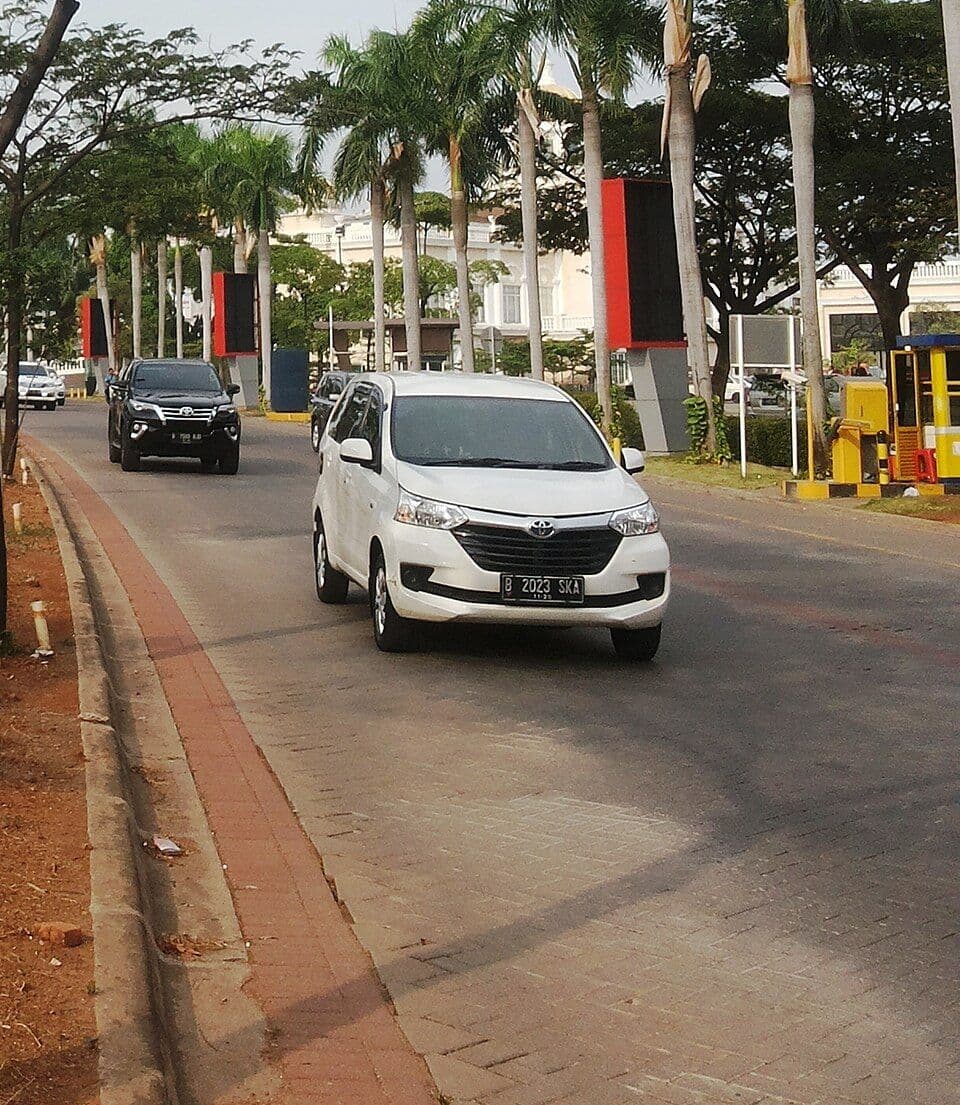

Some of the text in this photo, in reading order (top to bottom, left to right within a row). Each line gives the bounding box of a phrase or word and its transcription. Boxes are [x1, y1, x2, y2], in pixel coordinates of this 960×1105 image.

[505, 577, 580, 594] B 2023 SKA
